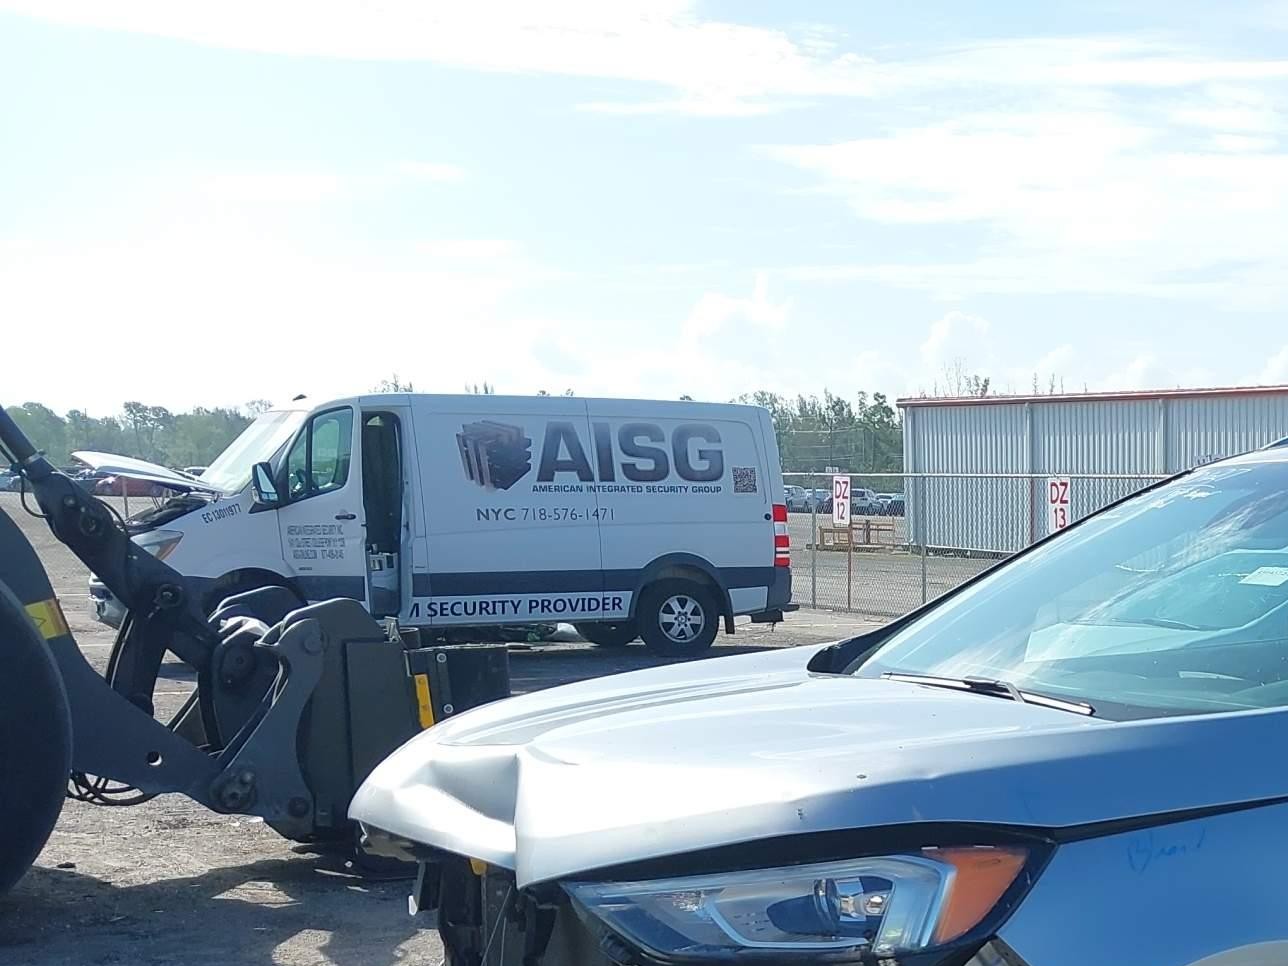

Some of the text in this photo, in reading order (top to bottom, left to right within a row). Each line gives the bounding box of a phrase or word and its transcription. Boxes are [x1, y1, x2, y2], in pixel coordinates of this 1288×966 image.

[536, 420, 725, 483] AISG
[532, 484, 722, 495] AMERICAN INTEGRATED SECURITY GROUP
[834, 480, 849, 500] DZ
[1050, 481, 1069, 505] DZ
[476, 507, 615, 521] NYC 718-576-1471
[836, 501, 845, 521] 12
[1053, 507, 1067, 529] 13
[426, 599, 522, 618] SECURITY
[528, 596, 624, 614] PROVIDER
